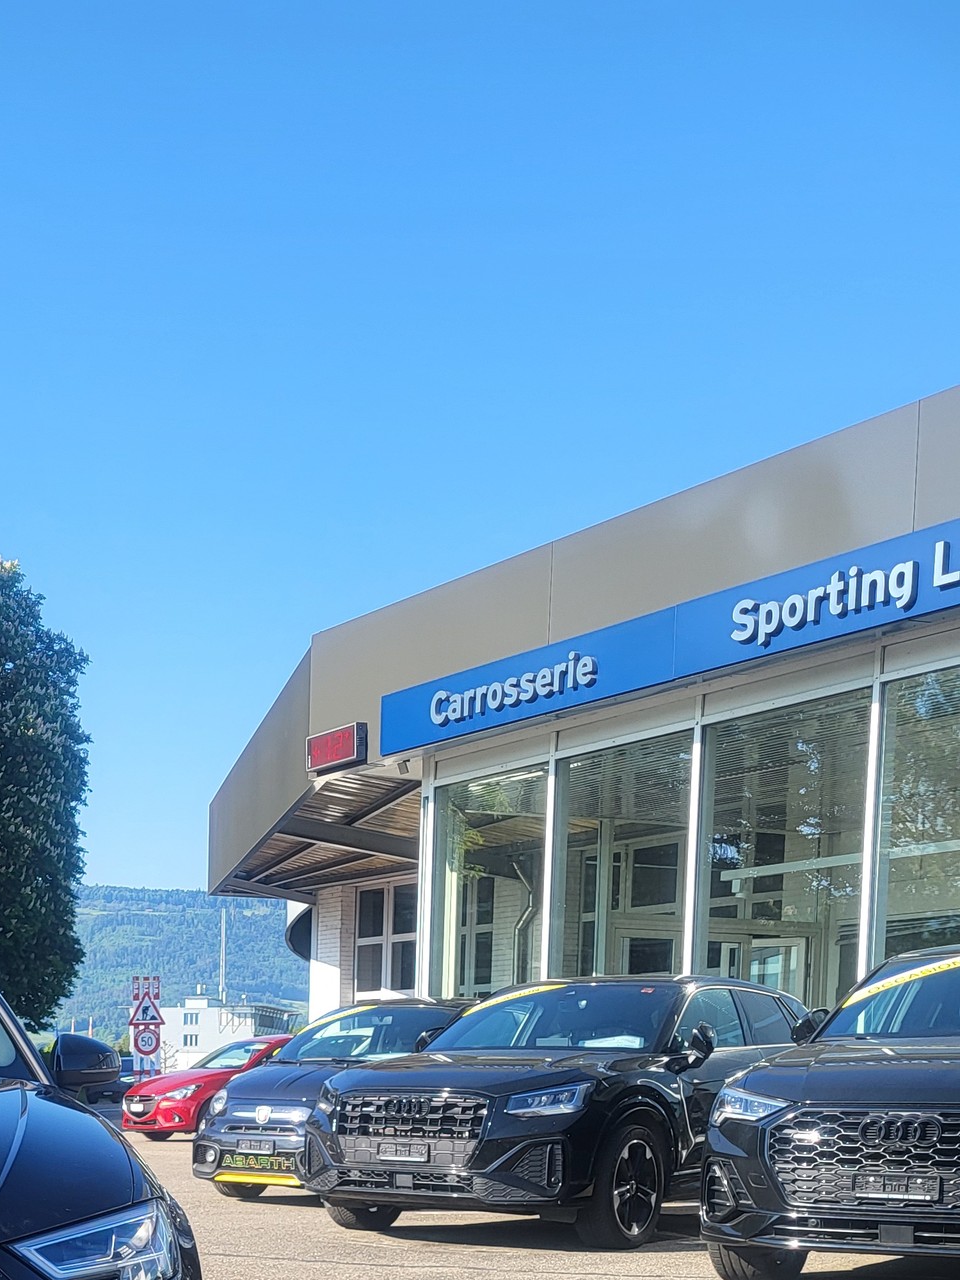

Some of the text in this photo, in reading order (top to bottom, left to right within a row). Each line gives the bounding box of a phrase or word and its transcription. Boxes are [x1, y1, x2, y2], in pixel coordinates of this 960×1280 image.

[430, 651, 597, 727] Carrosserie
[730, 560, 918, 649] Sporting
[141, 1036, 153, 1047] 50
[222, 1154, 296, 1170] ABARTH
